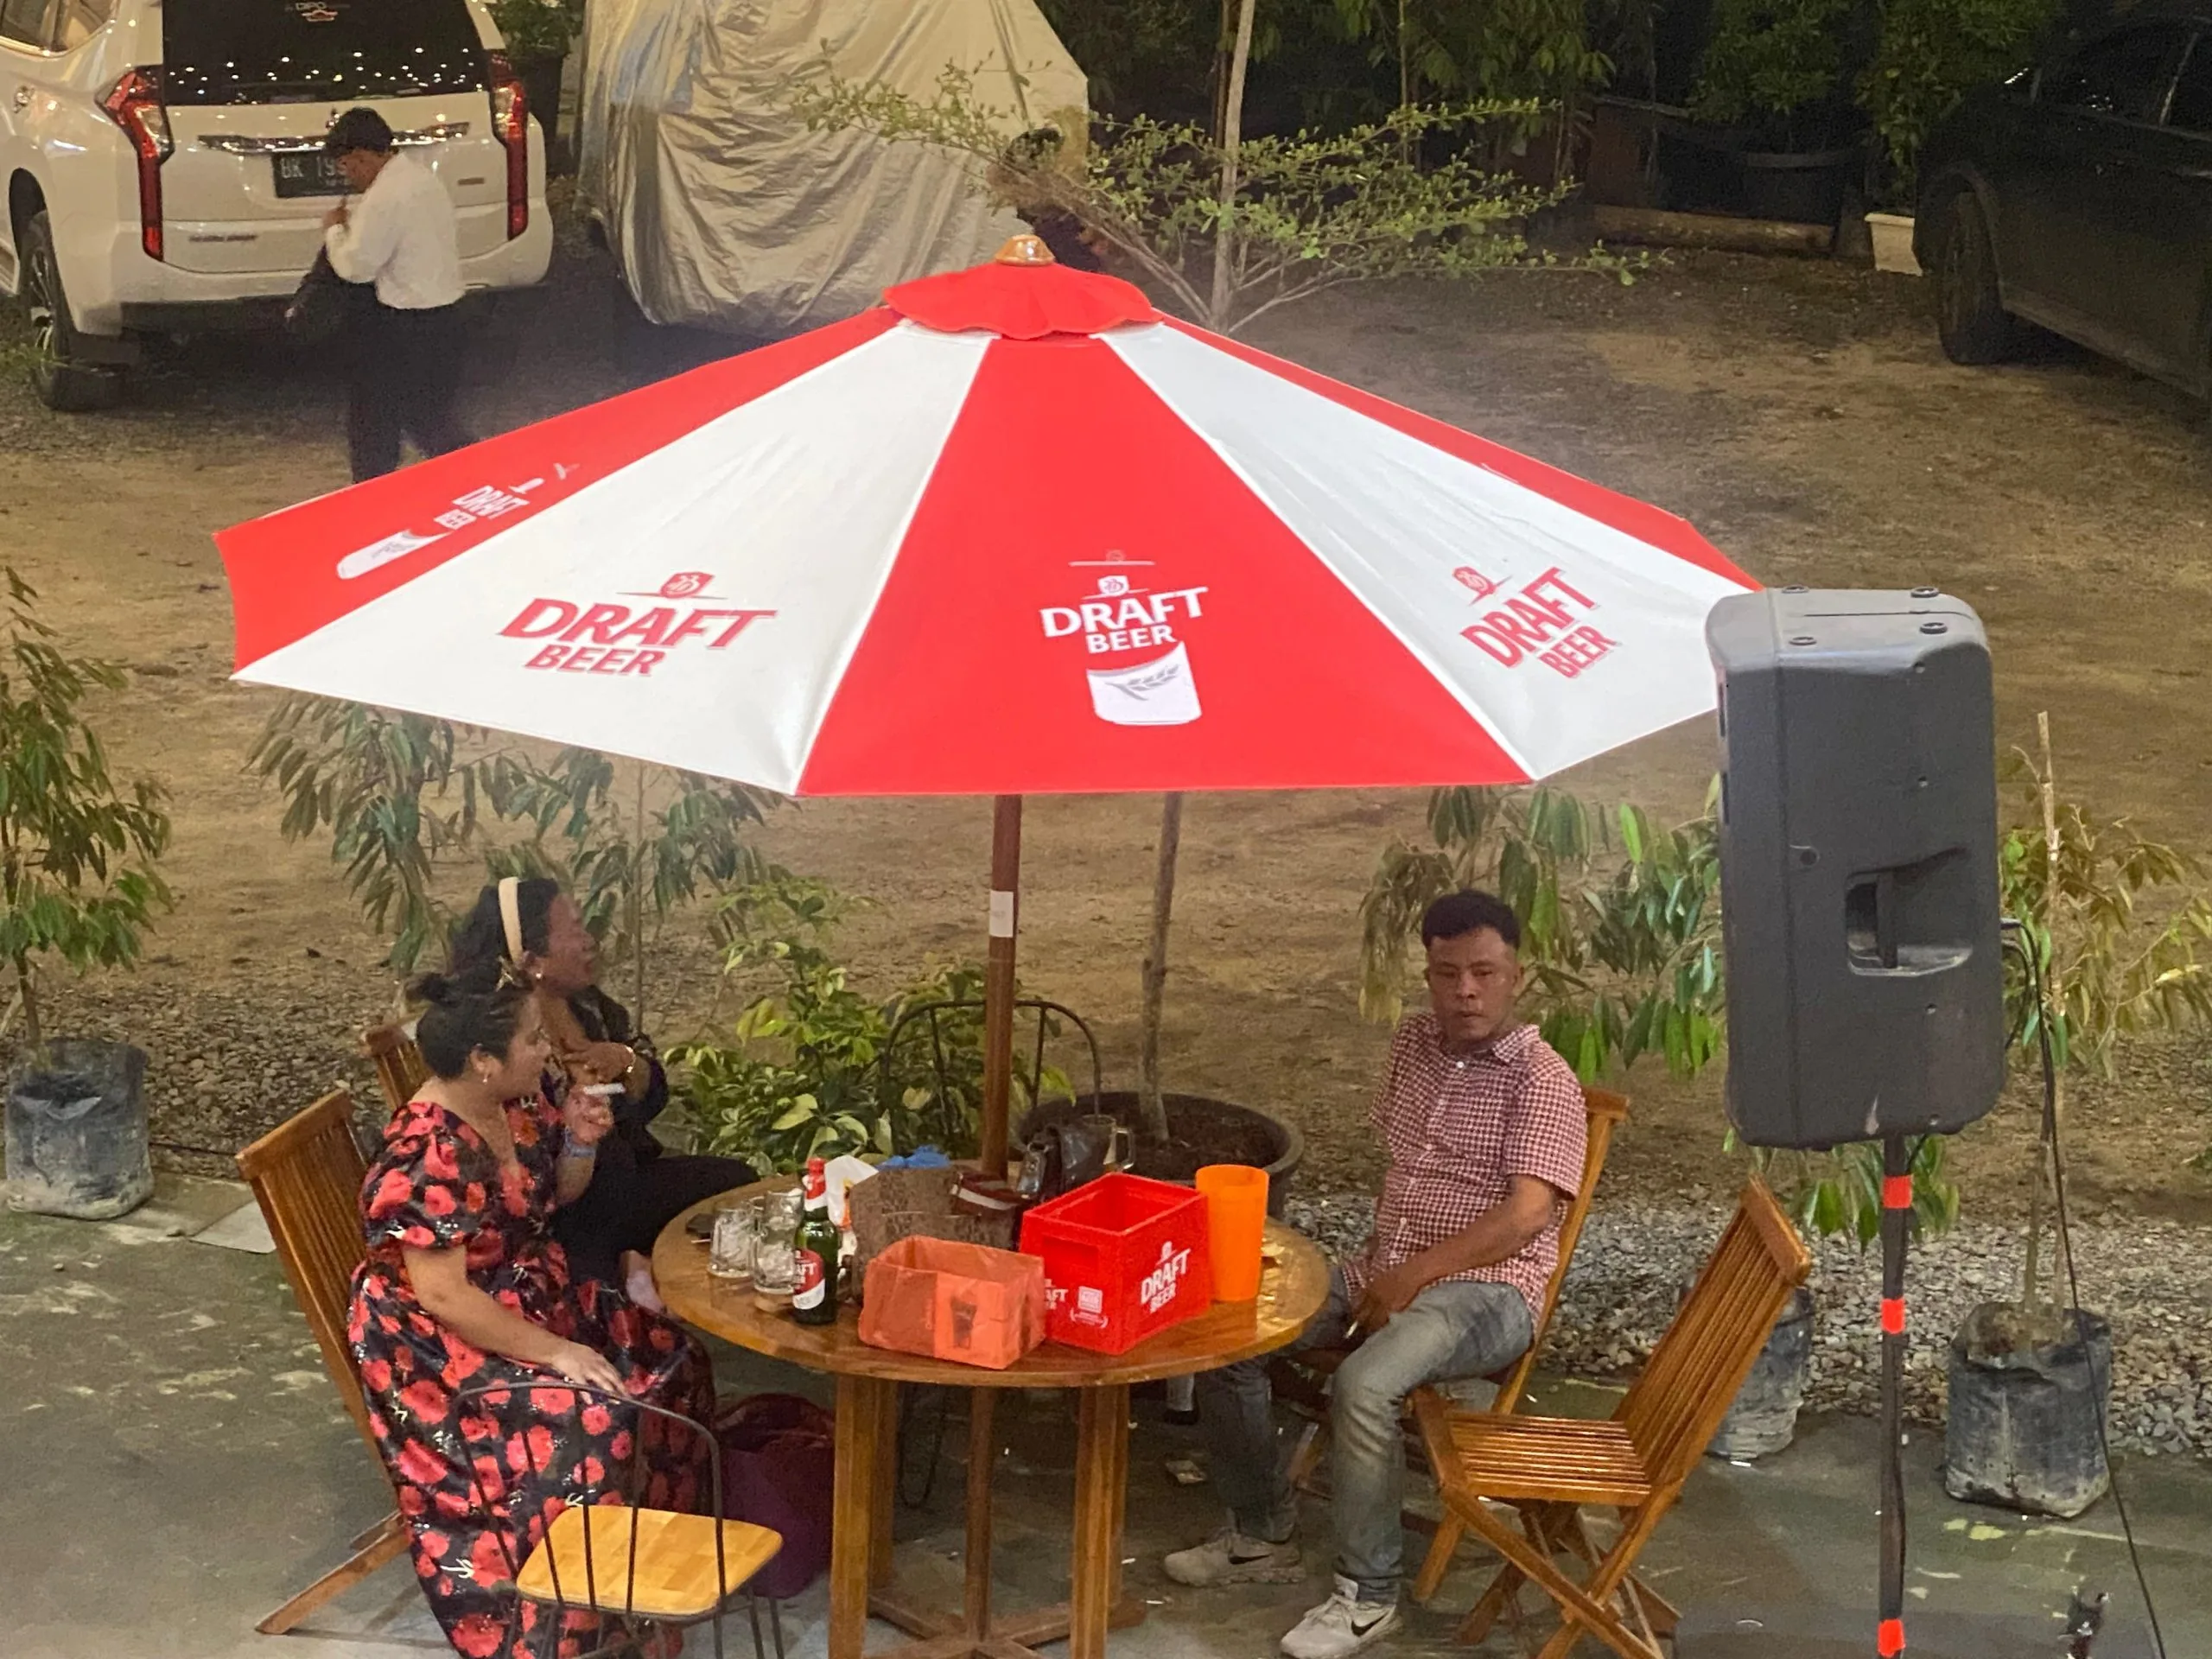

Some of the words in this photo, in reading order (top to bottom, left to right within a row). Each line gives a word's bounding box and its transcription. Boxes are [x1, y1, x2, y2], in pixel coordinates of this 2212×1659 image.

[496, 598, 778, 650] DRAFT
[1039, 586, 1209, 638] DRAFT
[1459, 566, 1599, 670] DRAFT
[524, 644, 666, 677] BEER
[1084, 625, 1179, 654] BEER
[1537, 625, 1619, 679] BEER
[1141, 1247, 1192, 1306] DRAFT
